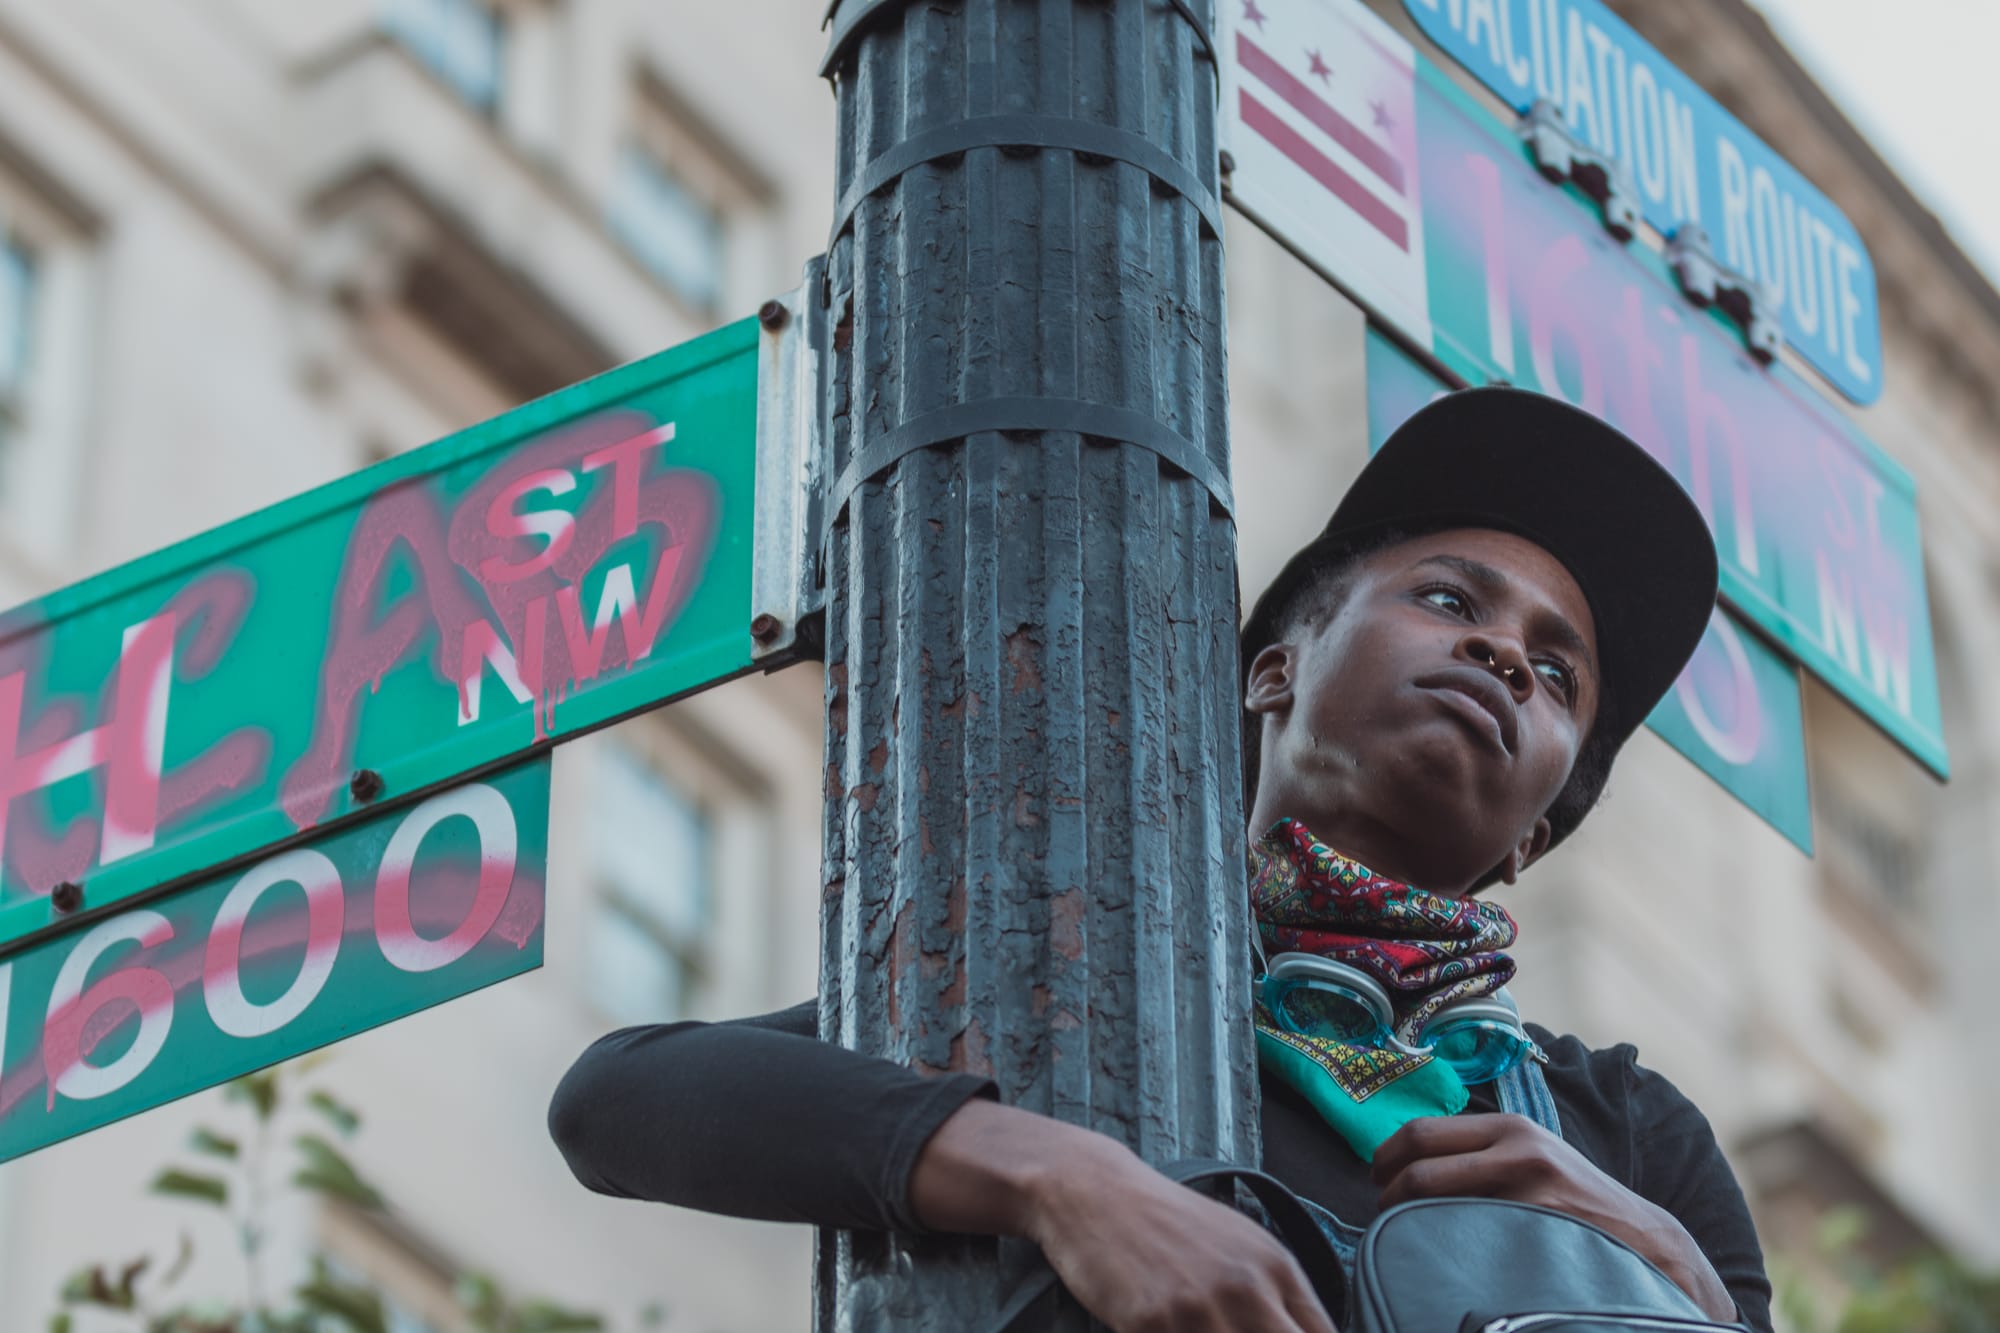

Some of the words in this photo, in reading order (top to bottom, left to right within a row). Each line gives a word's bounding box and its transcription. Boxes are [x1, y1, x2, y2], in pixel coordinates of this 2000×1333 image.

[1419, 0, 1700, 224] CUATION
[1717, 133, 1872, 384] ROUTE
[480, 422, 677, 583] ST
[458, 543, 684, 727] NW
[1815, 546, 1911, 718] NW
[0, 783, 518, 1100] 600
